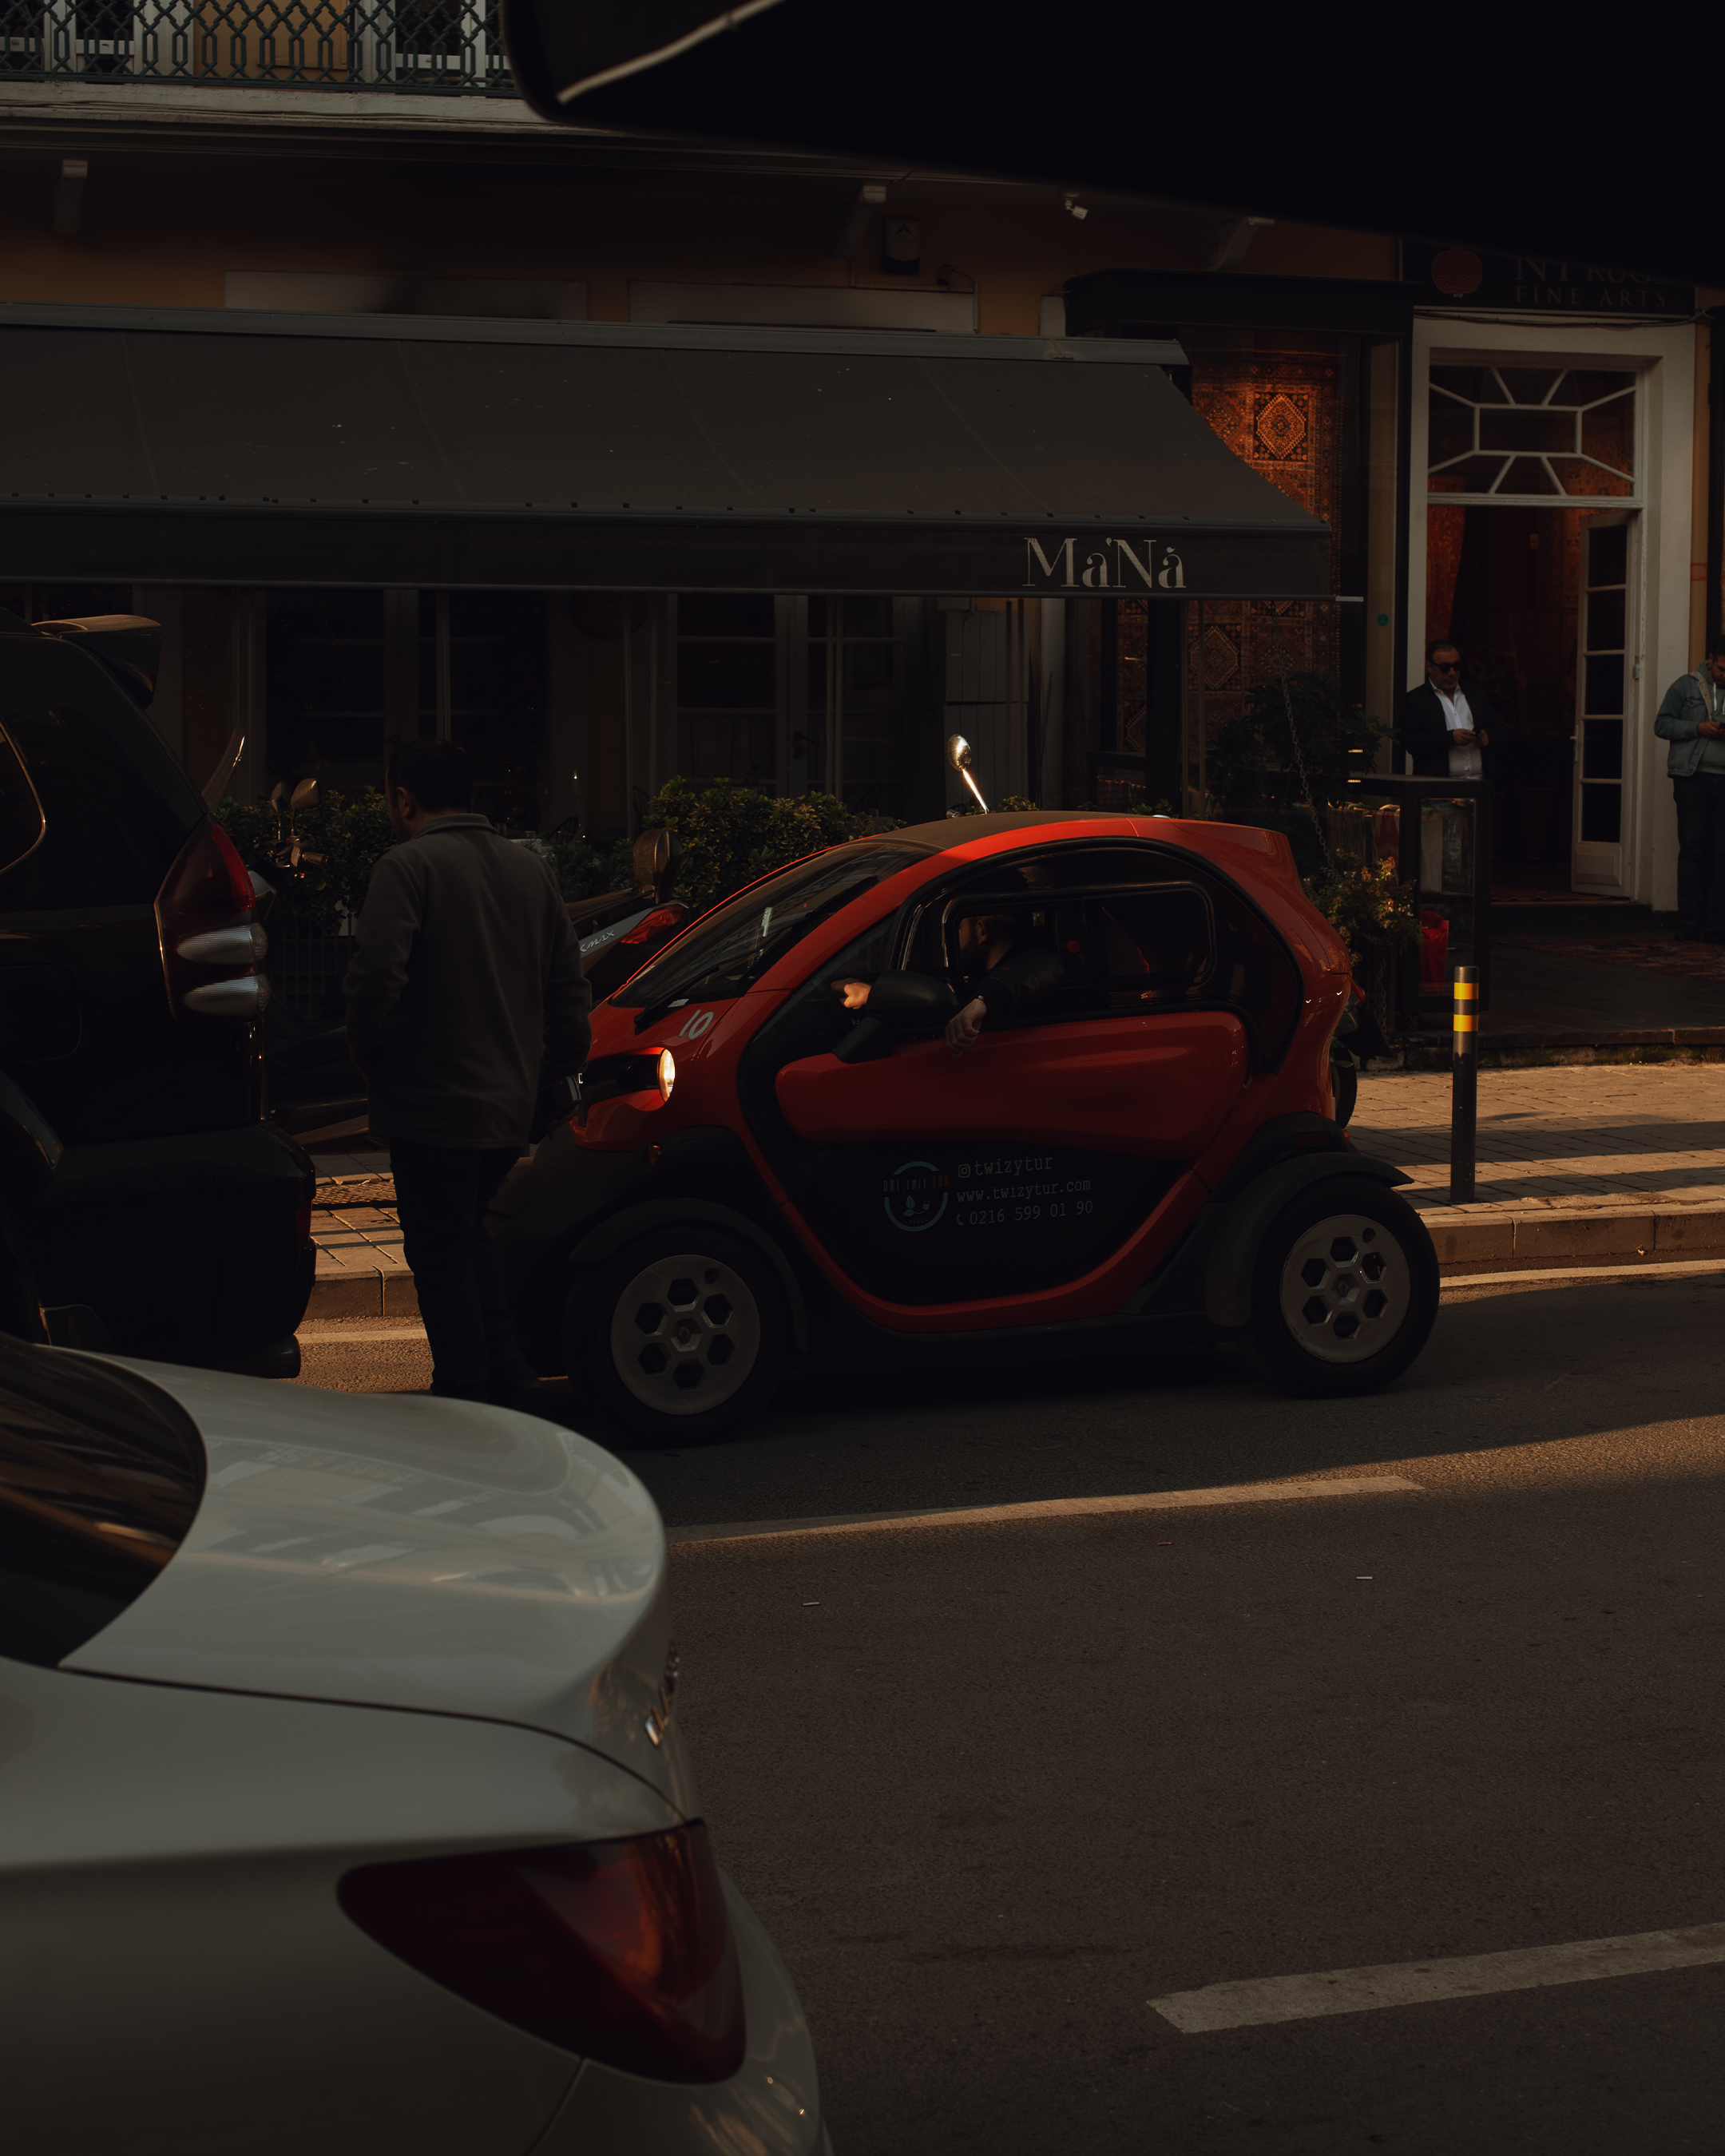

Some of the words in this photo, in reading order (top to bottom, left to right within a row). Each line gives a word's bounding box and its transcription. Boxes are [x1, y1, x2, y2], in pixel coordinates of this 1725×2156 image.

[1515, 286, 1580, 305] FINE
[1599, 289, 1666, 308] ARTS
[678, 1009, 715, 1040] 10
[974, 1155, 1053, 1176] twizytur
[957, 1179, 1092, 1203] www.twizytur.com
[969, 1207, 1005, 1226] 0216
[1014, 1204, 1041, 1222] 599
[1049, 1203, 1067, 1218] 01
[1076, 1199, 1093, 1215] 90
